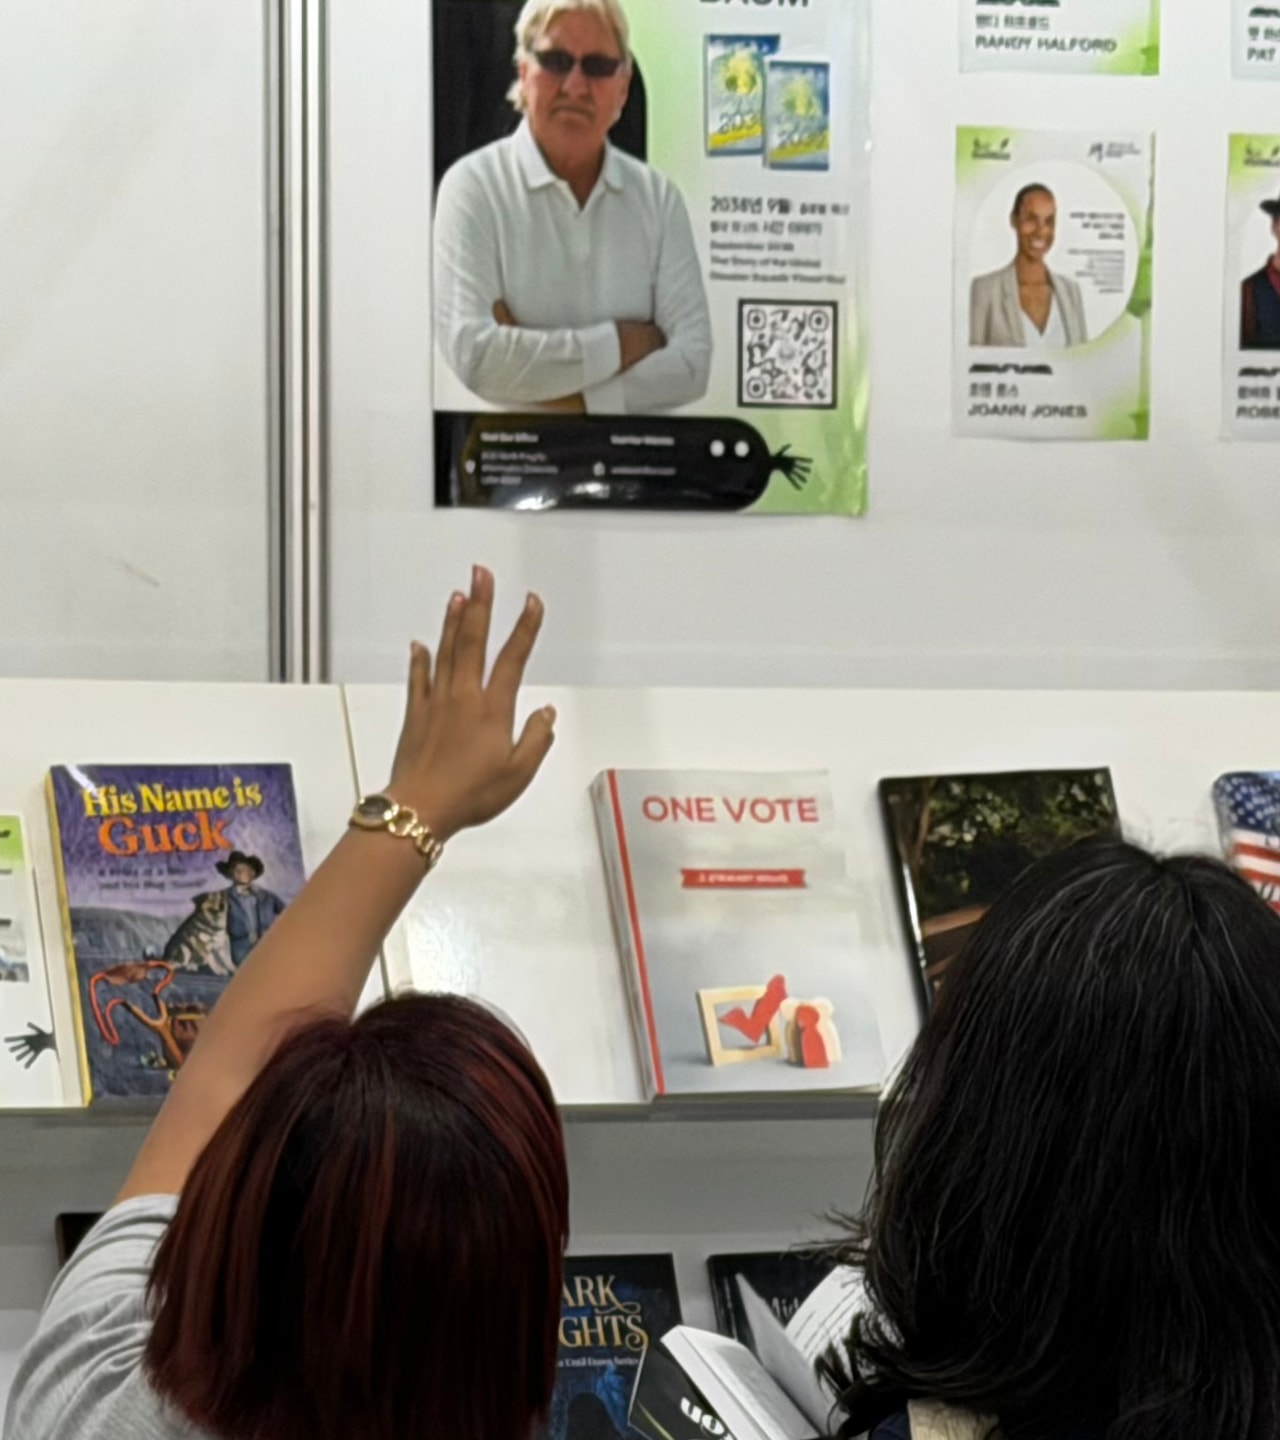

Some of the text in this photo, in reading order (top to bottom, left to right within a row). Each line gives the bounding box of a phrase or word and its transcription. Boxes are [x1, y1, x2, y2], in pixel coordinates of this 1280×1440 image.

[975, 35, 1118, 53] RANDY HALFORD
[1247, 47, 1277, 62] PAT
[968, 403, 1088, 419] JOANN JONES
[82, 777, 264, 817] His Name is
[641, 796, 820, 824] ONE VOTE
[97, 811, 235, 858] Guck
[556, 1274, 641, 1315] ARK
[558, 1315, 649, 1350] GHTS
